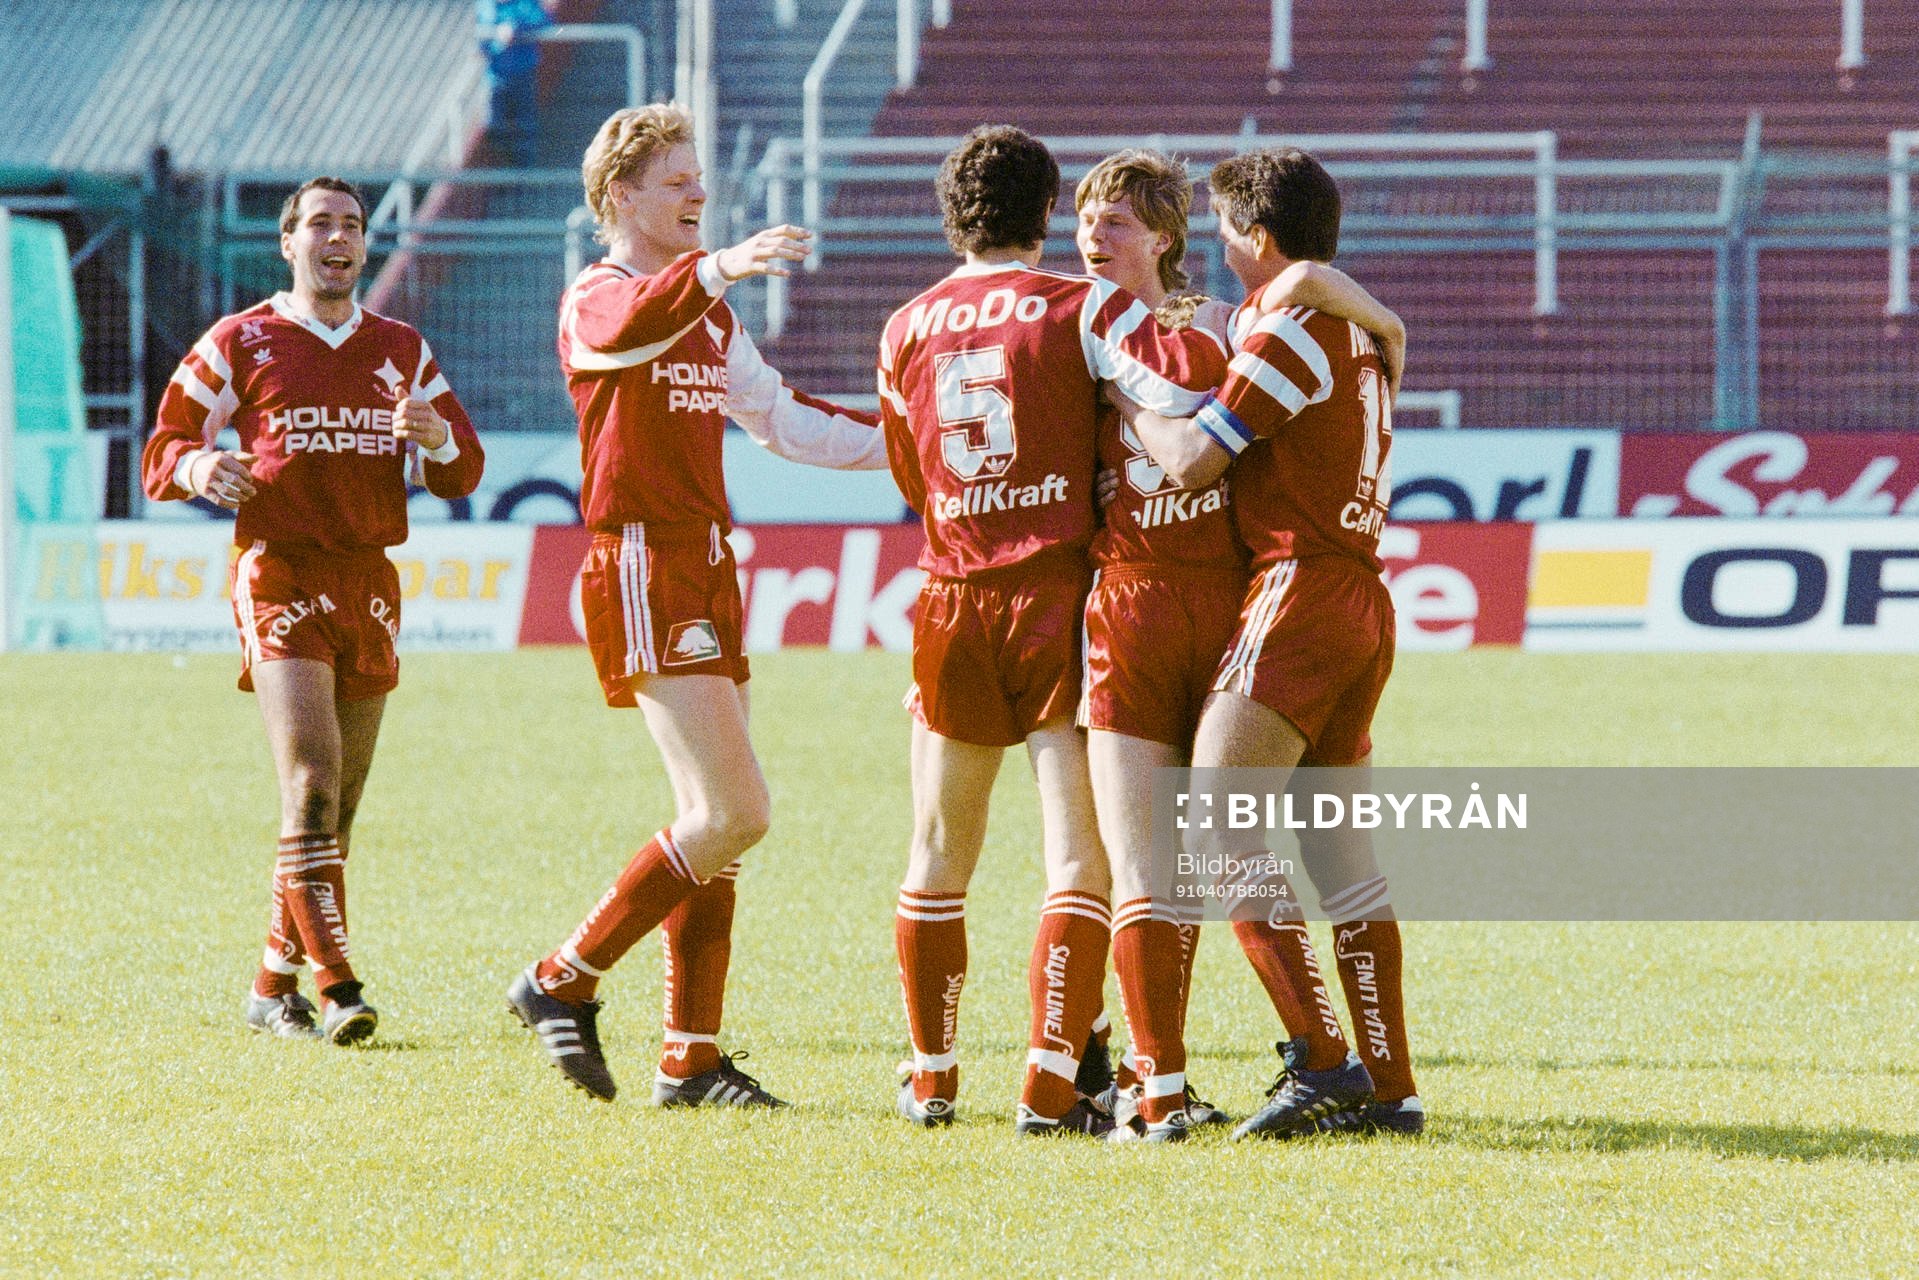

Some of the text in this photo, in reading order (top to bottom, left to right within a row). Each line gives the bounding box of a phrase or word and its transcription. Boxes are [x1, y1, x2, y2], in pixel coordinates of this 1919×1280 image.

[903, 287, 1048, 341] MoDo
[267, 405, 394, 433] HOLME
[284, 432, 397, 456] PAPER
[933, 343, 1017, 483] 5
[934, 474, 1069, 521] CellKraft
[1043, 943, 1071, 1039] SILJA LINE
[1296, 932, 1343, 1041] SILJA LINE
[1354, 956, 1391, 1061] SILJA LINE
